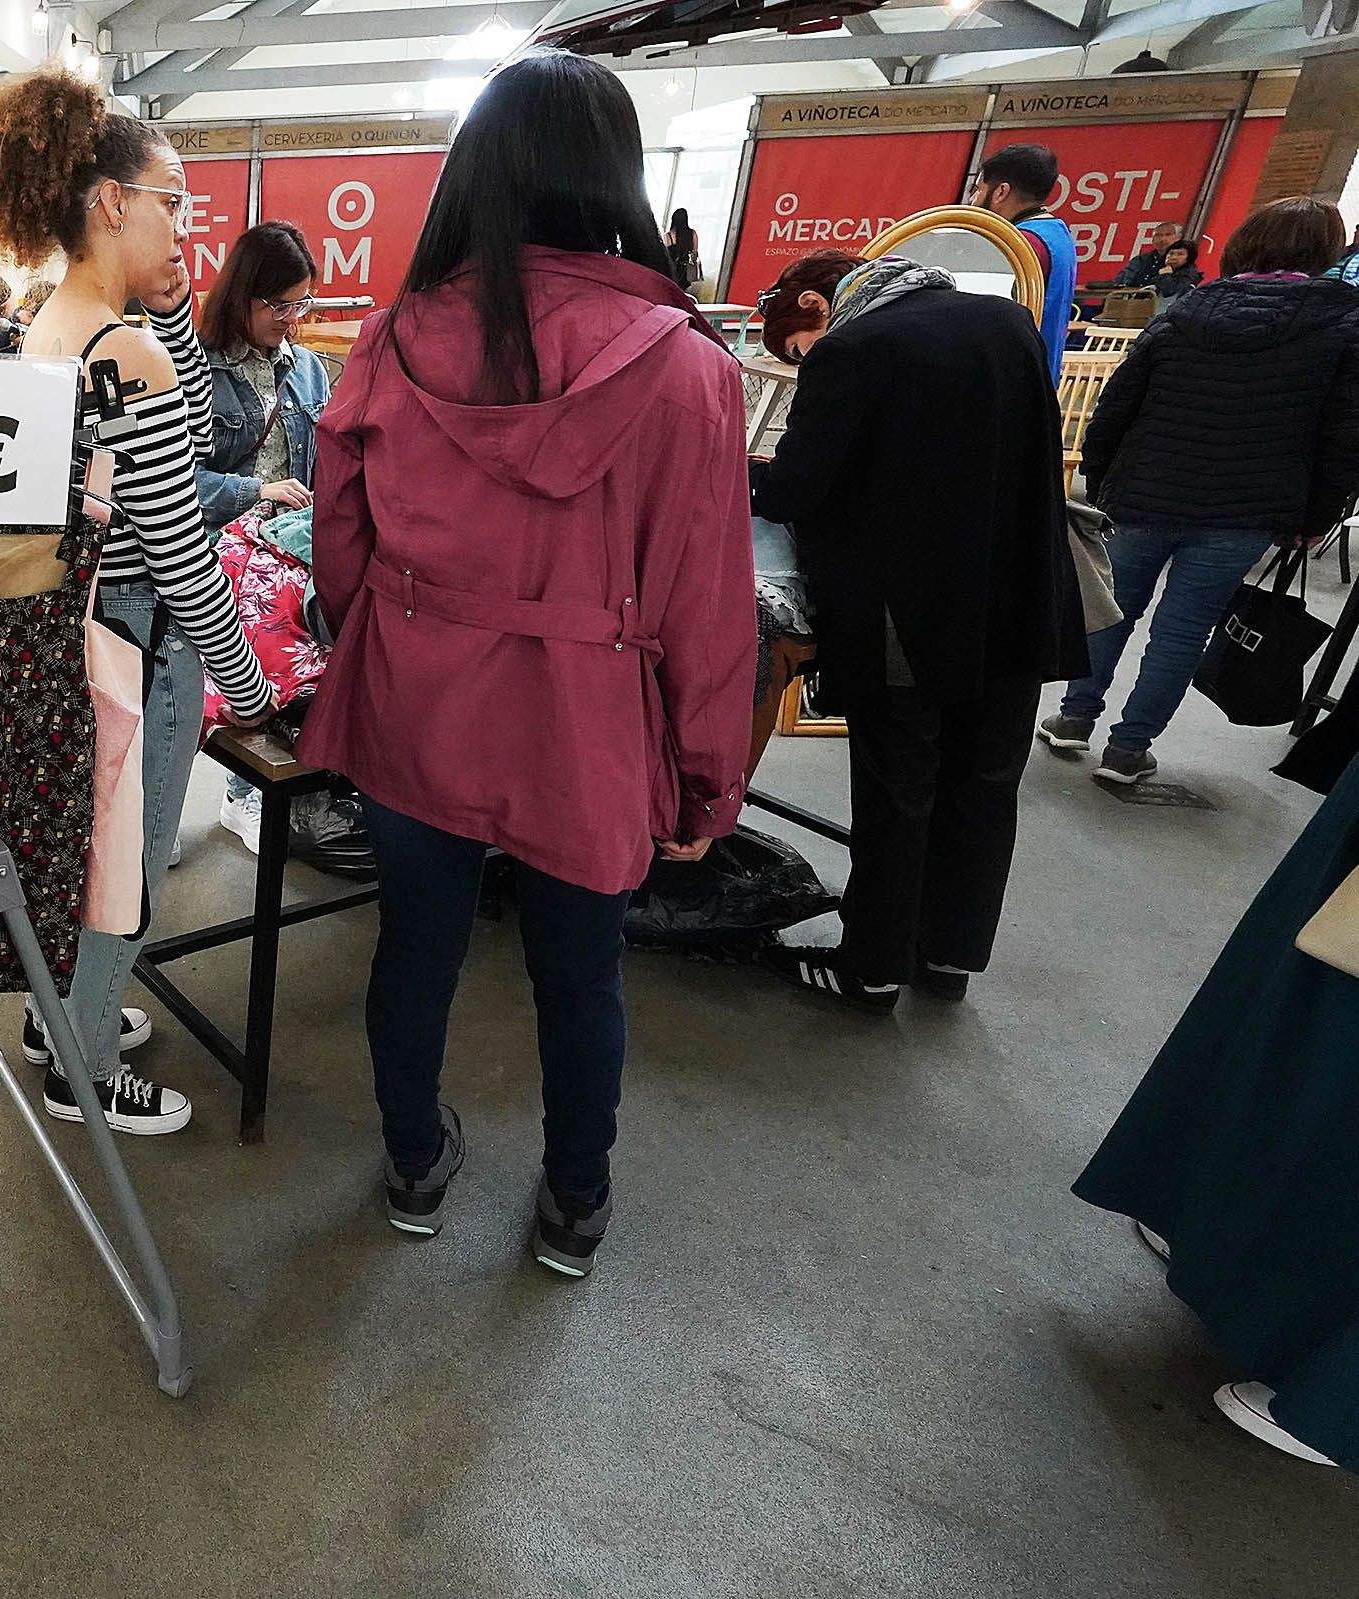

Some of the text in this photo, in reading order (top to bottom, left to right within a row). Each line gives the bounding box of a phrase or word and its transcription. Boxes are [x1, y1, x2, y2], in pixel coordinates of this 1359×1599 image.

[1003, 98, 1015, 113] A
[1021, 94, 1109, 113] VIÑOTECA
[781, 109, 793, 122] A
[797, 104, 880, 121] VIÑOTECA
[166, 131, 210, 150] OKE
[264, 131, 344, 147] CERVEXERIA
[768, 217, 896, 242] MERCAD
[765, 247, 799, 256] ESPAZO
